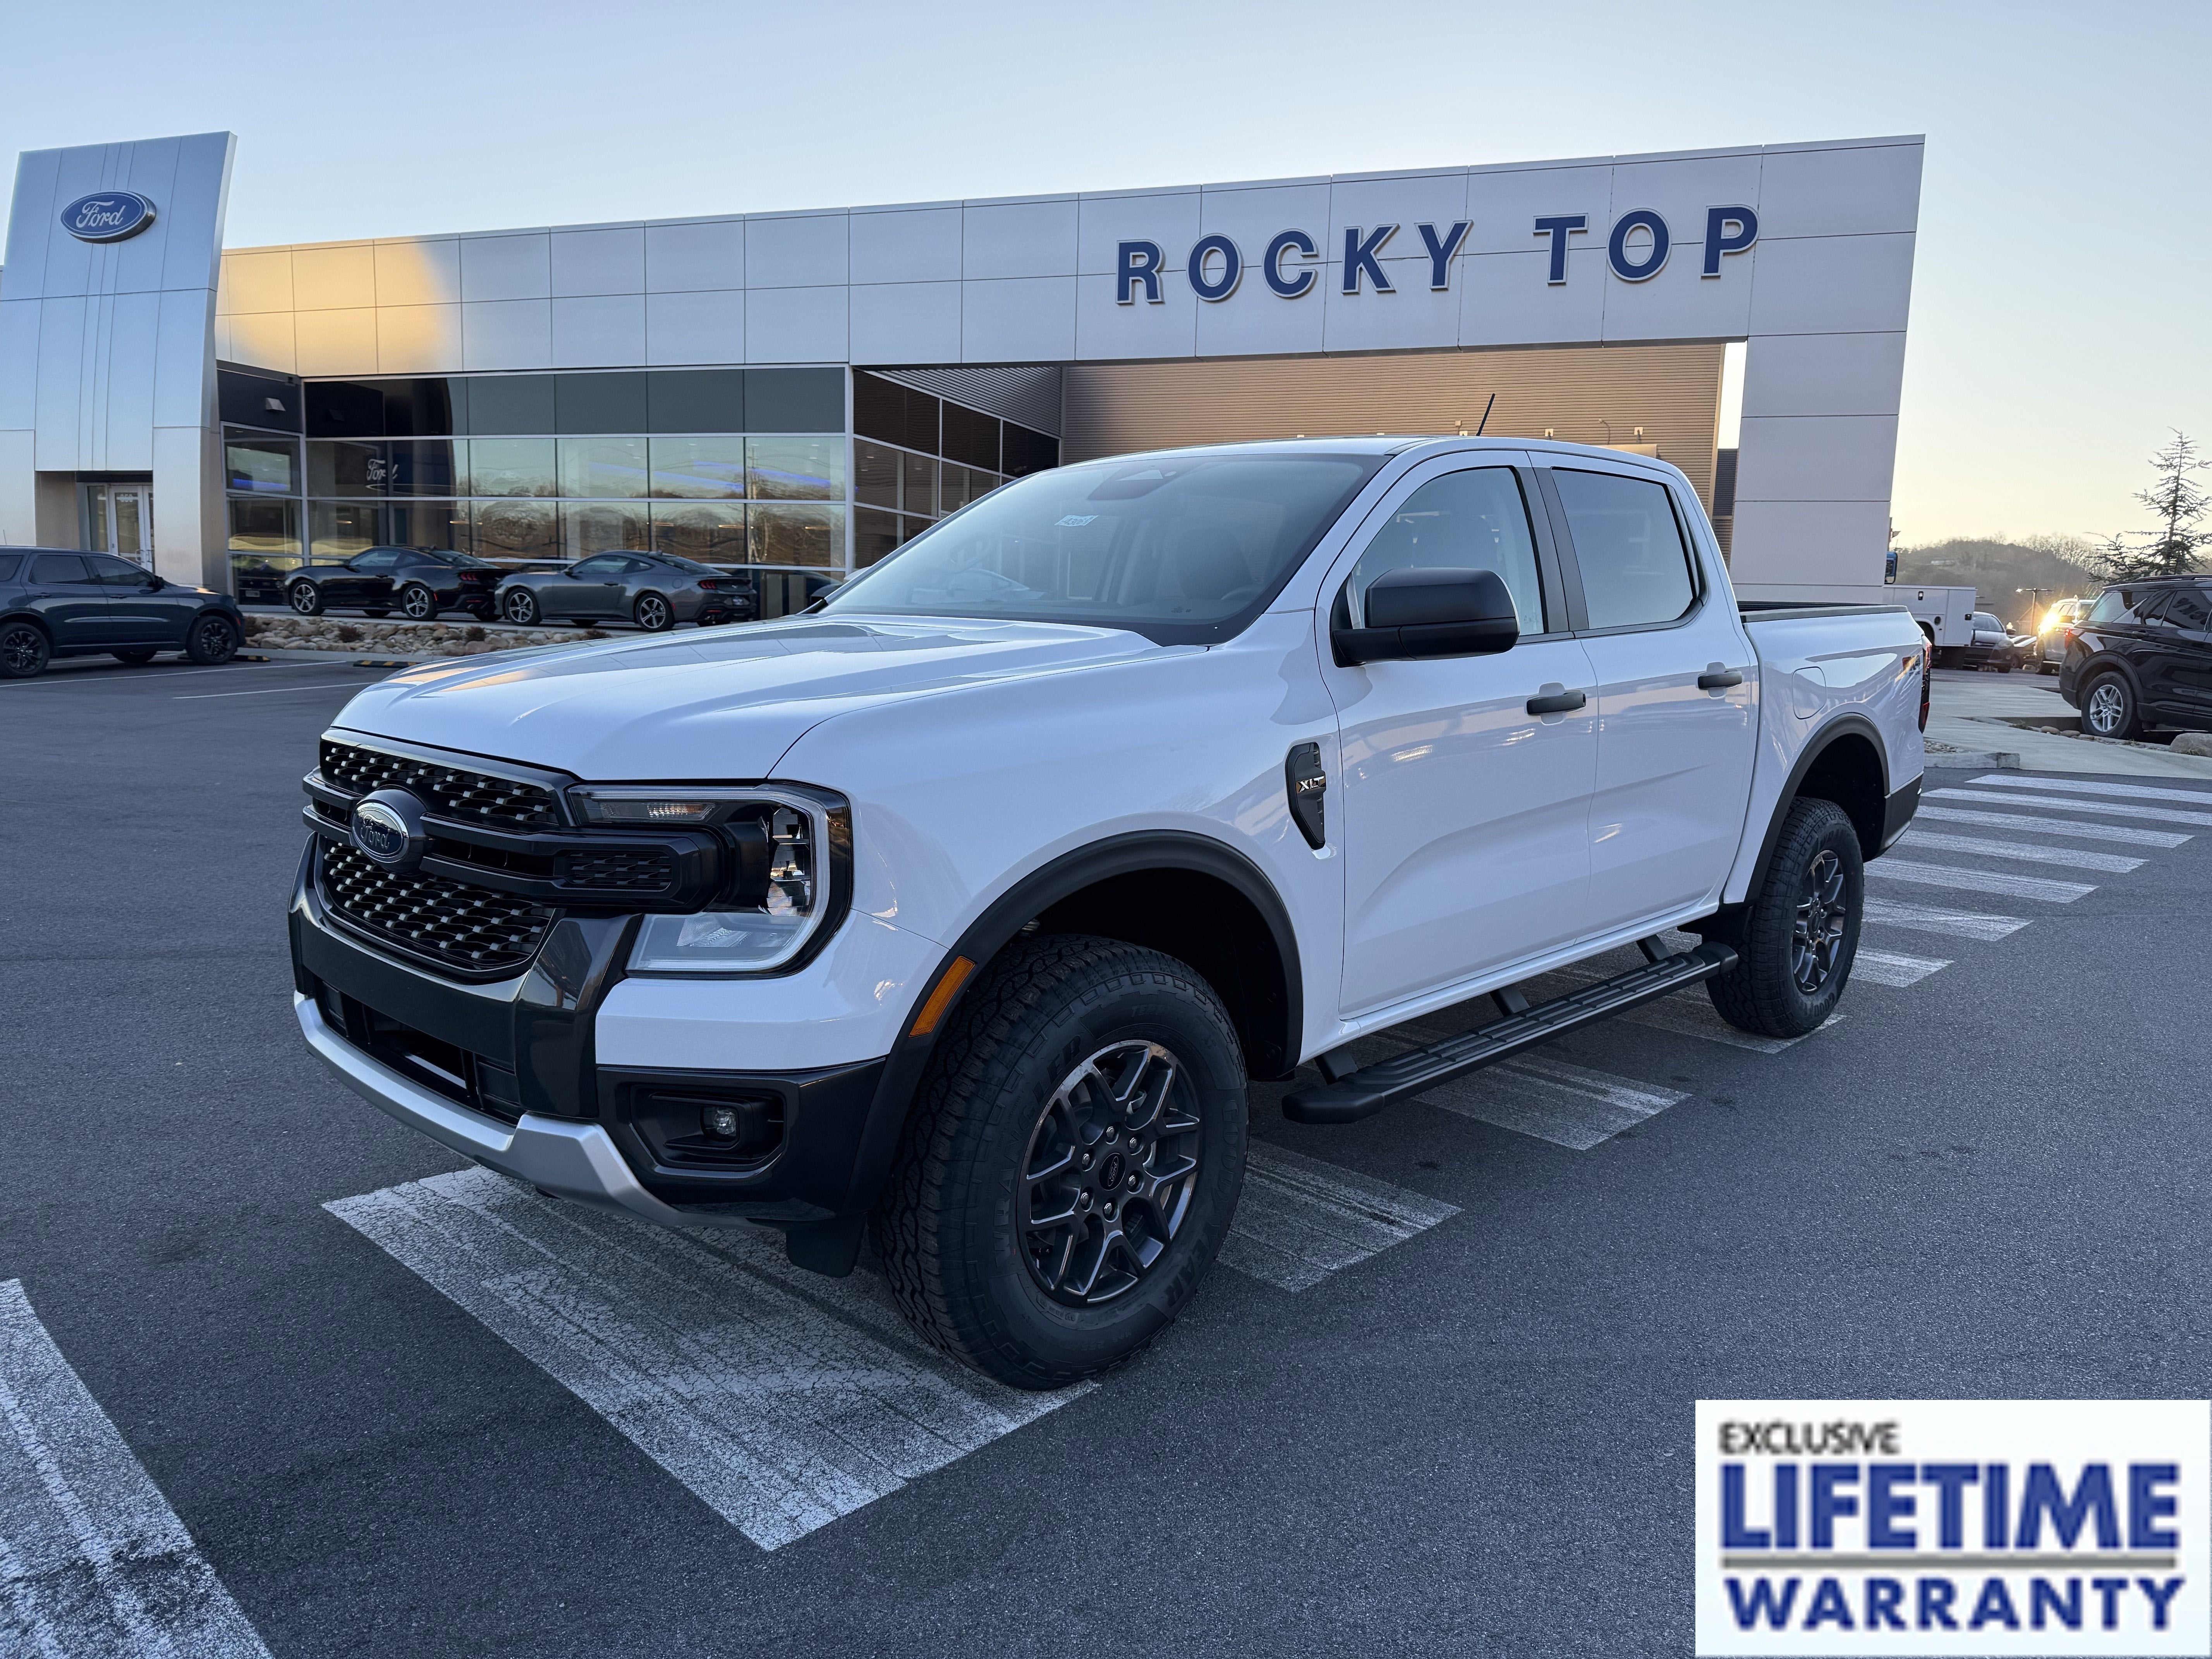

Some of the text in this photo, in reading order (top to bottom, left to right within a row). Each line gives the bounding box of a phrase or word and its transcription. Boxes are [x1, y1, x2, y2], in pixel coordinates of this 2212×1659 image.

[76, 201, 126, 228] Ford
[1116, 204, 1759, 303] ROCKY TOP
[1298, 776, 1324, 792] XLT
[361, 814, 390, 850] Ford
[993, 1035, 1082, 1269] WRANGLER
[1109, 1162, 1118, 1181] Ford
[1164, 1099, 1240, 1308] GOODYEAR
